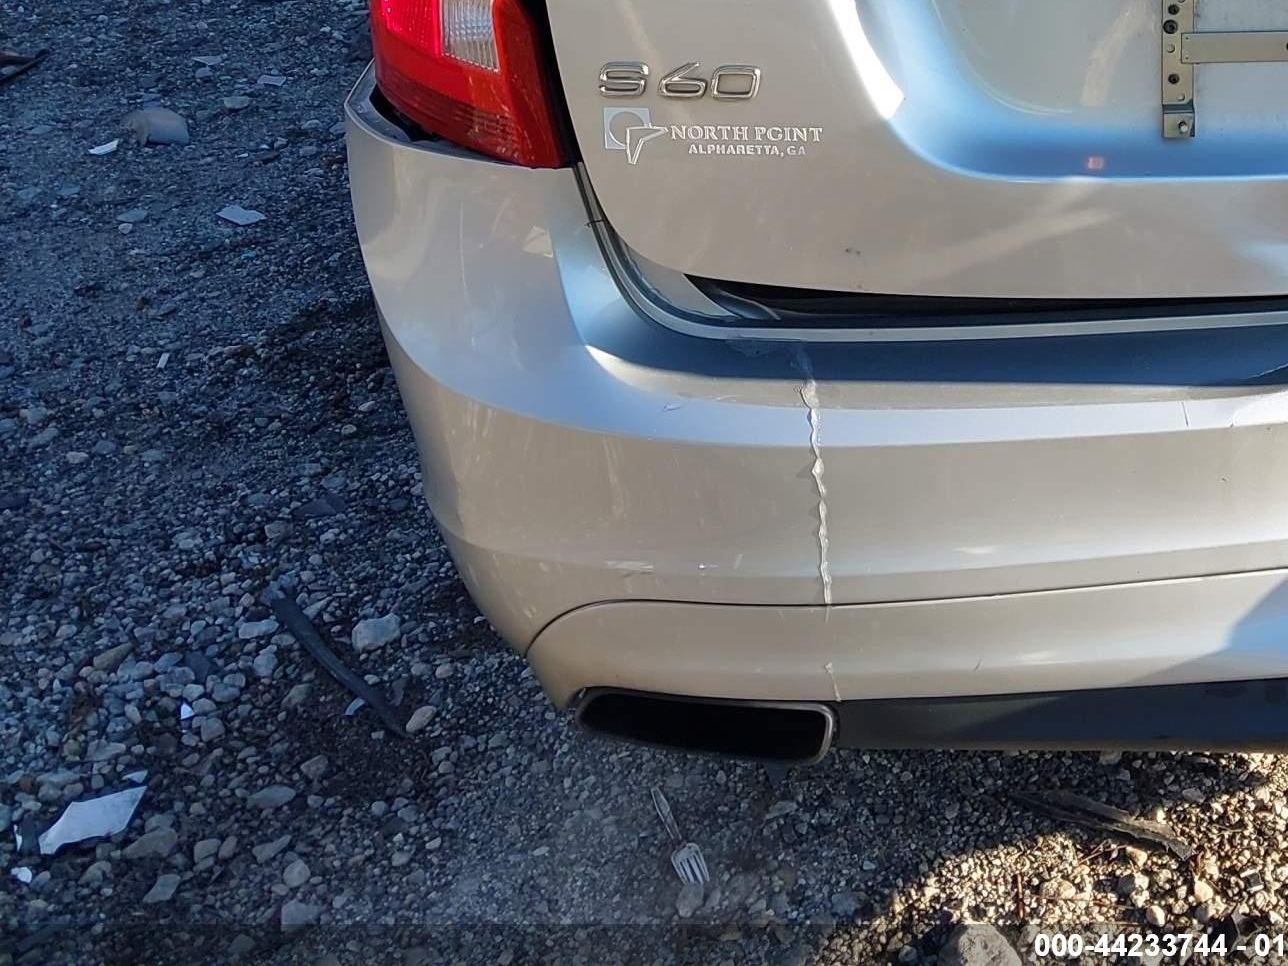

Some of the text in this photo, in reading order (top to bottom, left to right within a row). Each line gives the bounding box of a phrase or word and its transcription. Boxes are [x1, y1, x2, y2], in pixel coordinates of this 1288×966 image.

[599, 61, 762, 101] S60
[671, 125, 824, 142] NORTH POINT
[688, 144, 806, 158] ALPHARETTA, GA
